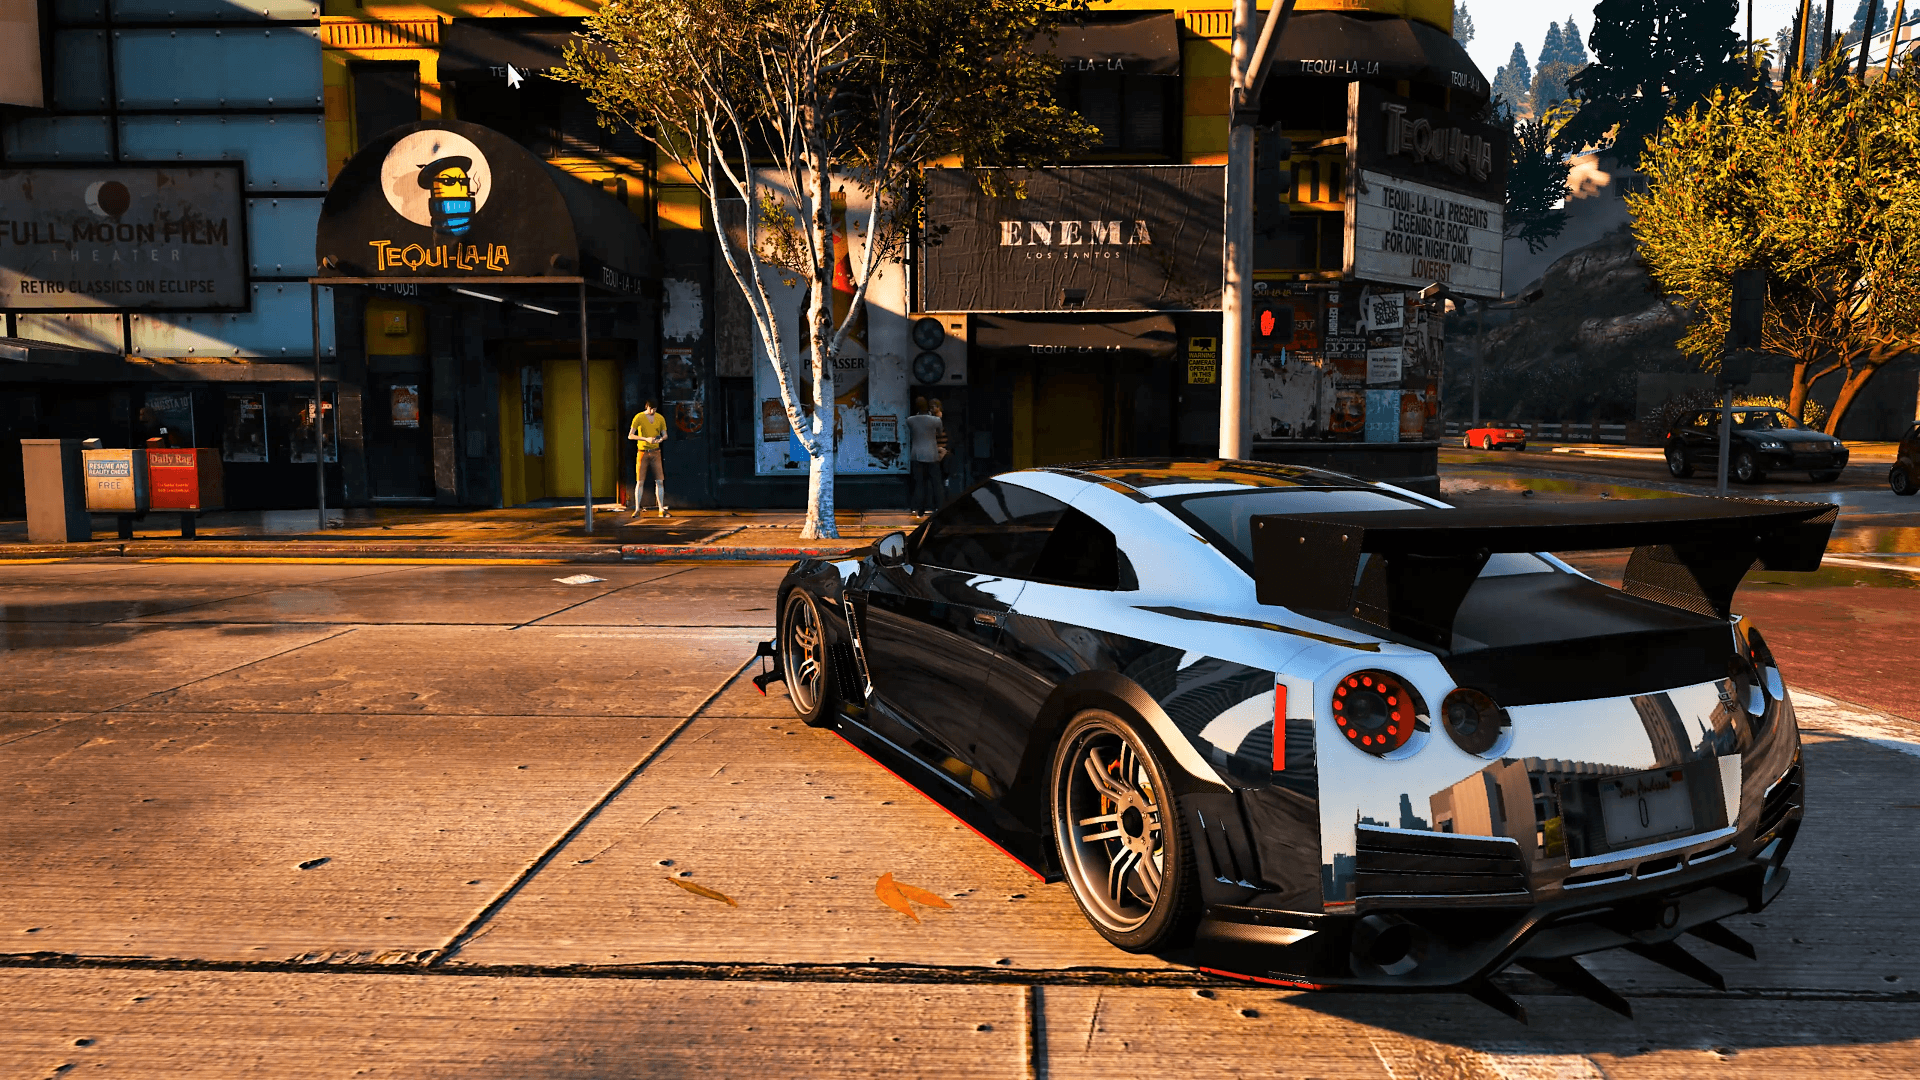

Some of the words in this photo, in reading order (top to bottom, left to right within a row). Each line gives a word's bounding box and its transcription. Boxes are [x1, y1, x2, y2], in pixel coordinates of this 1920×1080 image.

[1078, 59, 1096, 71] LA
[1107, 58, 1124, 71] LA
[1300, 59, 1337, 74] TEQUI
[1346, 60, 1358, 74] LA
[1367, 61, 1379, 75] LA
[1383, 187, 1410, 210] TEQUI
[1417, 195, 1427, 215] LA
[1434, 198, 1444, 219] LA
[1448, 202, 1488, 228] PRESENTS
[72, 222, 154, 242] MOON
[165, 218, 228, 246] FILM
[999, 219, 1152, 246] ENEMA
[1393, 211, 1432, 237] LEGENDS
[1434, 220, 1444, 238] OF
[1447, 223, 1468, 245] ROCK
[52, 249, 180, 262] THEATER
[368, 240, 510, 272] TEQUI-LA-LA
[1385, 231, 1403, 252] FOR
[1405, 235, 1423, 256] ONE
[1425, 239, 1450, 262] NIGHT
[1452, 244, 1472, 265] ONLY
[1412, 258, 1451, 282] LOVEFIST
[21, 280, 65, 294] RETRO
[69, 280, 132, 294] CLASSICS
[136, 280, 155, 294] ON
[159, 280, 215, 293] ECLIPSE
[1029, 344, 1066, 354] TEQUI
[151, 454, 175, 465] Daily
[176, 454, 192, 465] Rag
